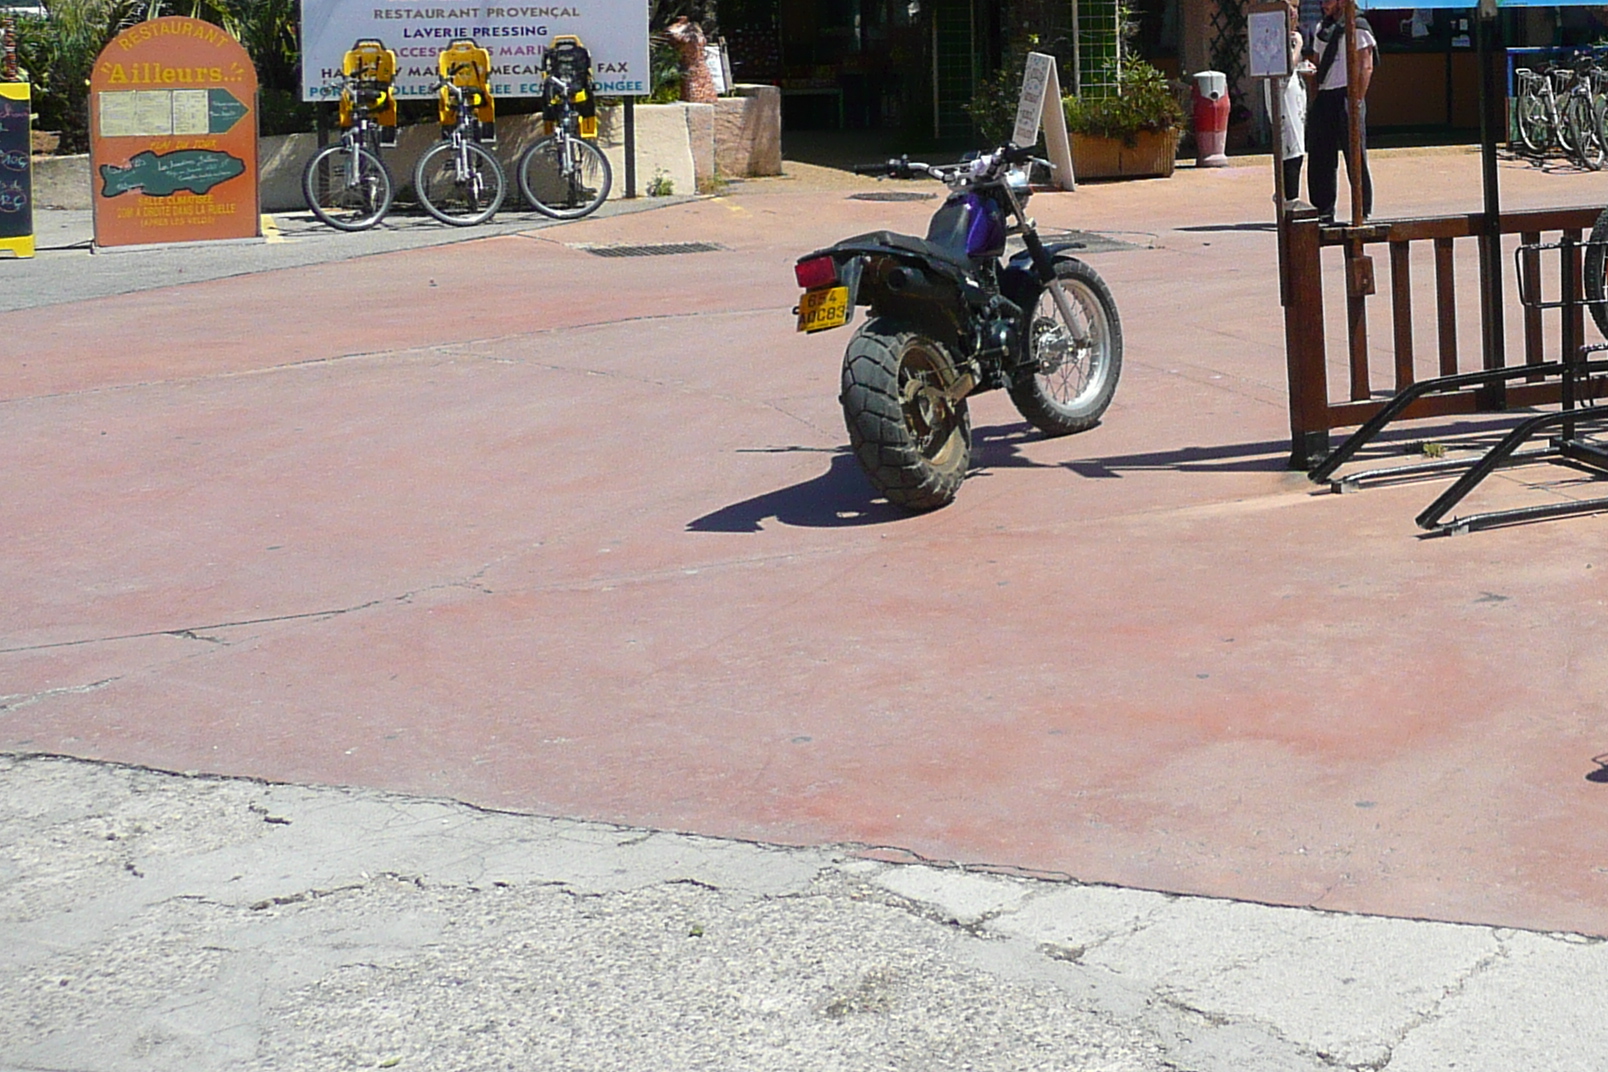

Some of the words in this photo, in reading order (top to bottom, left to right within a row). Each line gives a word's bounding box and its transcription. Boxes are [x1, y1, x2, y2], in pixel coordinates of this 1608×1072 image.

[373, 7, 481, 20] RESTAURANT
[486, 5, 580, 21] PROVENÇAL
[118, 21, 229, 52] RESTAURANT
[403, 26, 468, 39] LAVERIE
[472, 25, 548, 38] PRESSING
[500, 43, 547, 57] MARI
[597, 61, 629, 73] FAX
